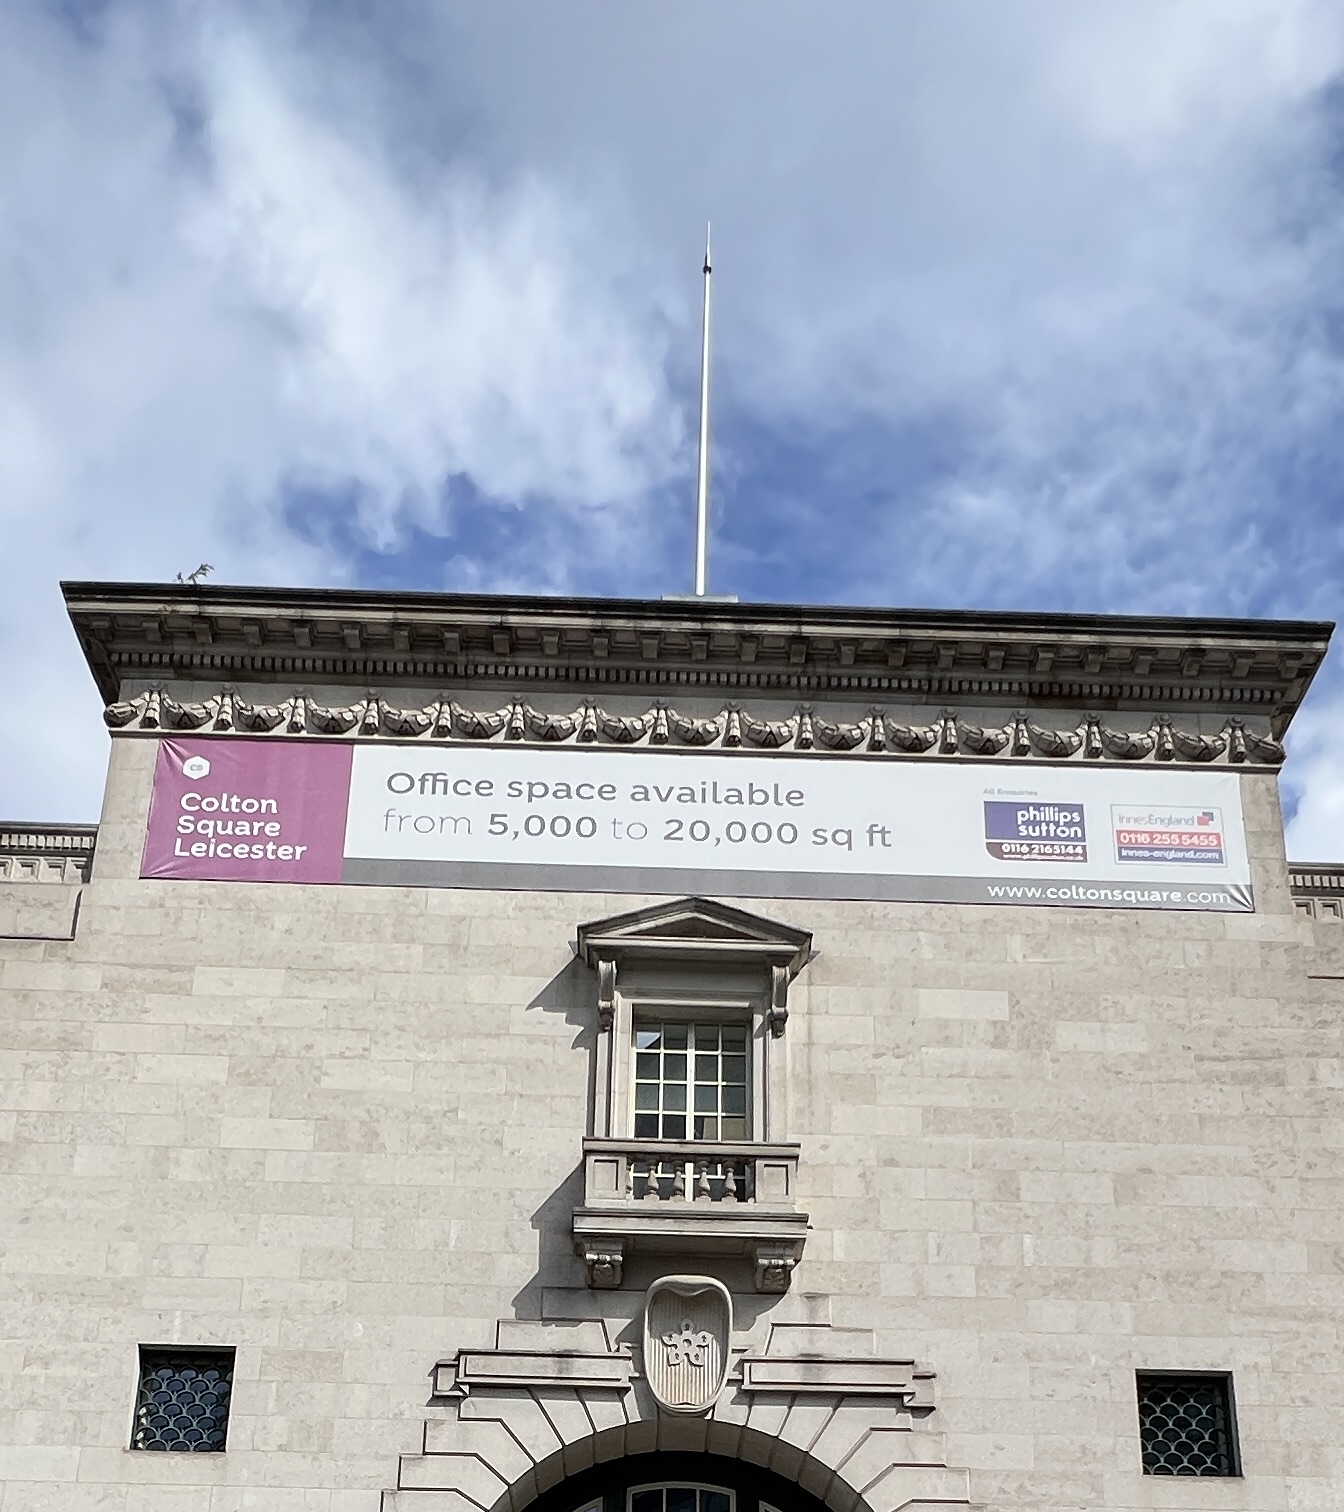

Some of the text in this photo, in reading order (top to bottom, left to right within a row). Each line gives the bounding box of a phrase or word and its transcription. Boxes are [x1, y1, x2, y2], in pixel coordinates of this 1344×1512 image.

[387, 772, 805, 807] Office space available
[180, 792, 278, 813] Colton
[1017, 806, 1081, 826] phillips
[176, 815, 281, 838] Square
[384, 808, 892, 851] from 5,000 to 20,000 sq ft
[1018, 822, 1082, 838] sutton
[174, 837, 308, 861] Leicester
[1001, 843, 1084, 854] 0116 2165144
[1120, 832, 1151, 844] 0116
[1181, 835, 1218, 847] 5455
[986, 885, 1232, 904] www.coltonsquare.com
